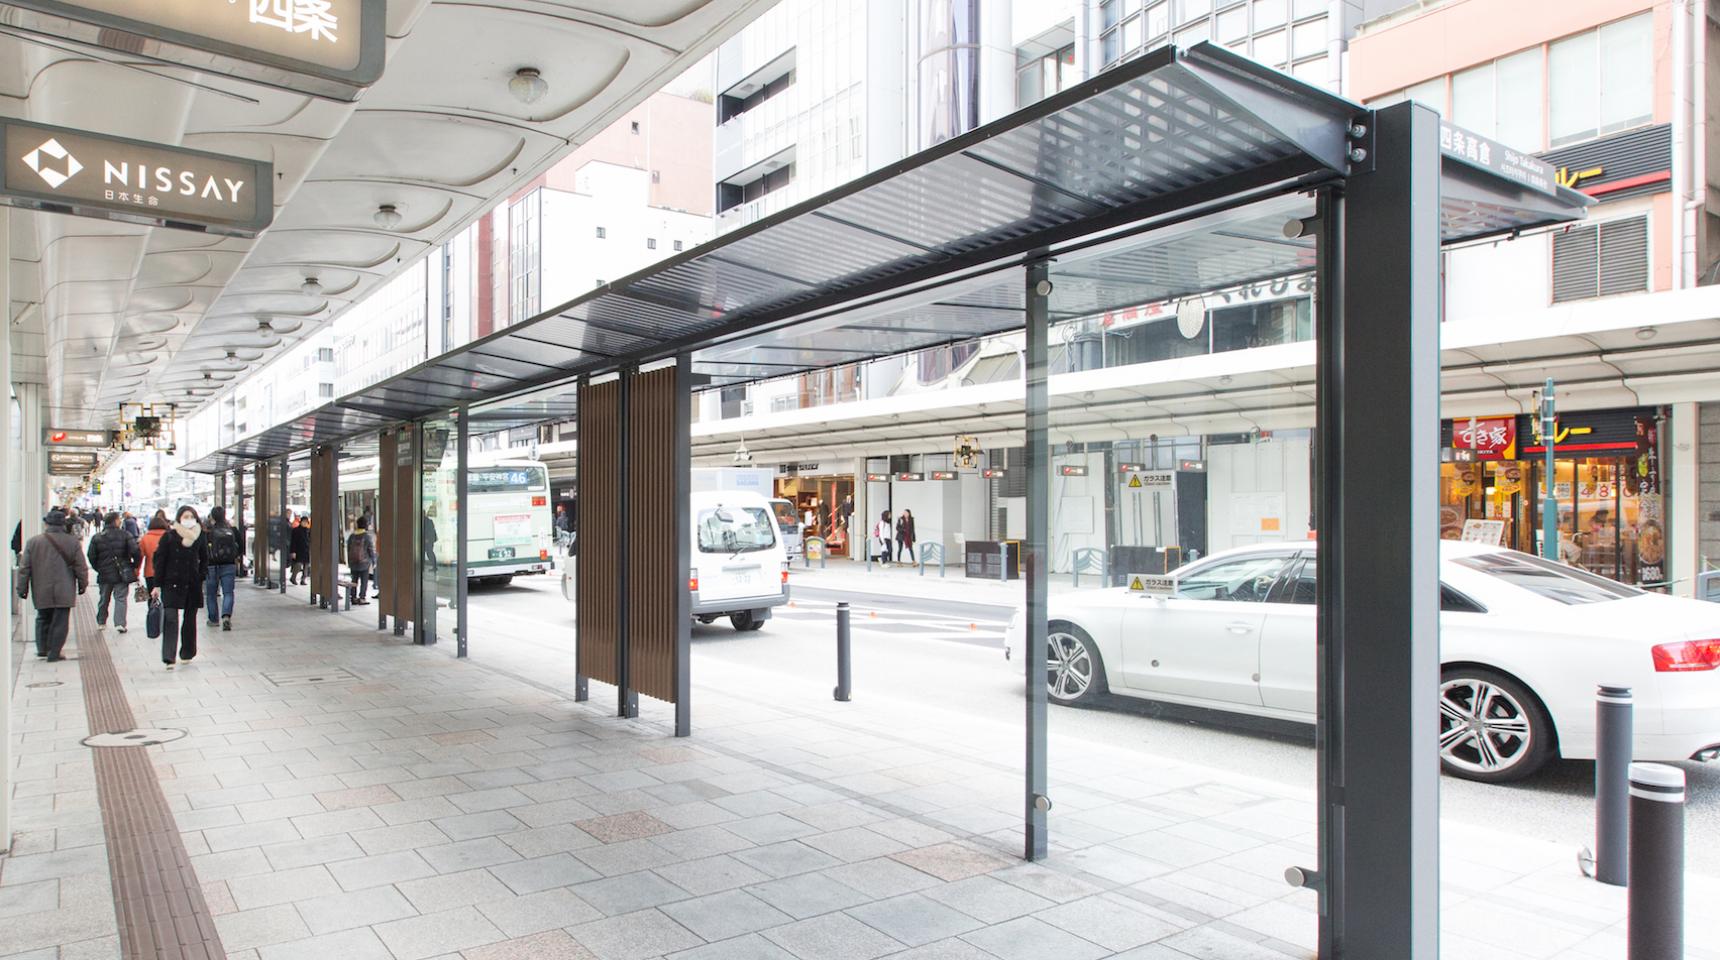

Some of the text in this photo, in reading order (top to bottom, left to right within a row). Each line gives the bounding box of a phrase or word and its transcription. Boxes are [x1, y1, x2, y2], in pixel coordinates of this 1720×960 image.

[1440, 126, 1490, 165] 四条高倉
[104, 160, 244, 203] NISSAY
[104, 190, 158, 206] 日本生命
[510, 472, 526, 484] 46
